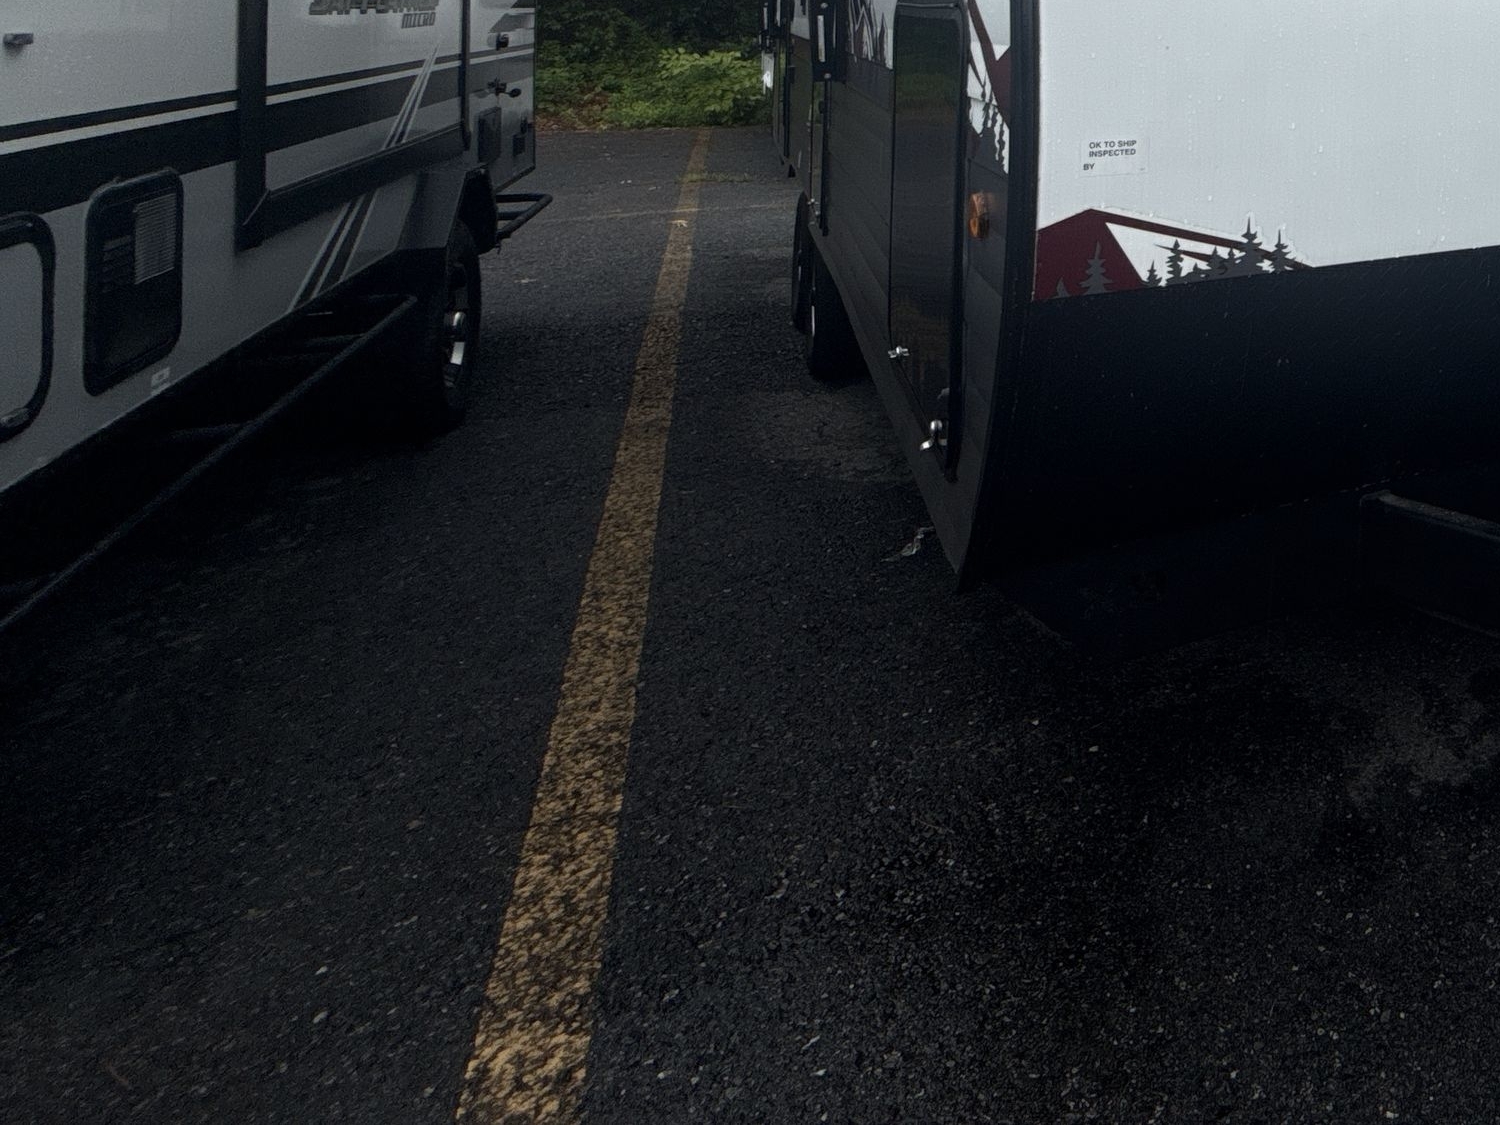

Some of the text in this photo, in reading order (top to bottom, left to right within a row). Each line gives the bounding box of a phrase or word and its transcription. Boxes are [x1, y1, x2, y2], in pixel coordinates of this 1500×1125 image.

[1089, 141, 1102, 149] OK
[1104, 140, 1116, 148] TO
[1089, 148, 1136, 158] INSPECTED
[1083, 163, 1095, 171] BY
